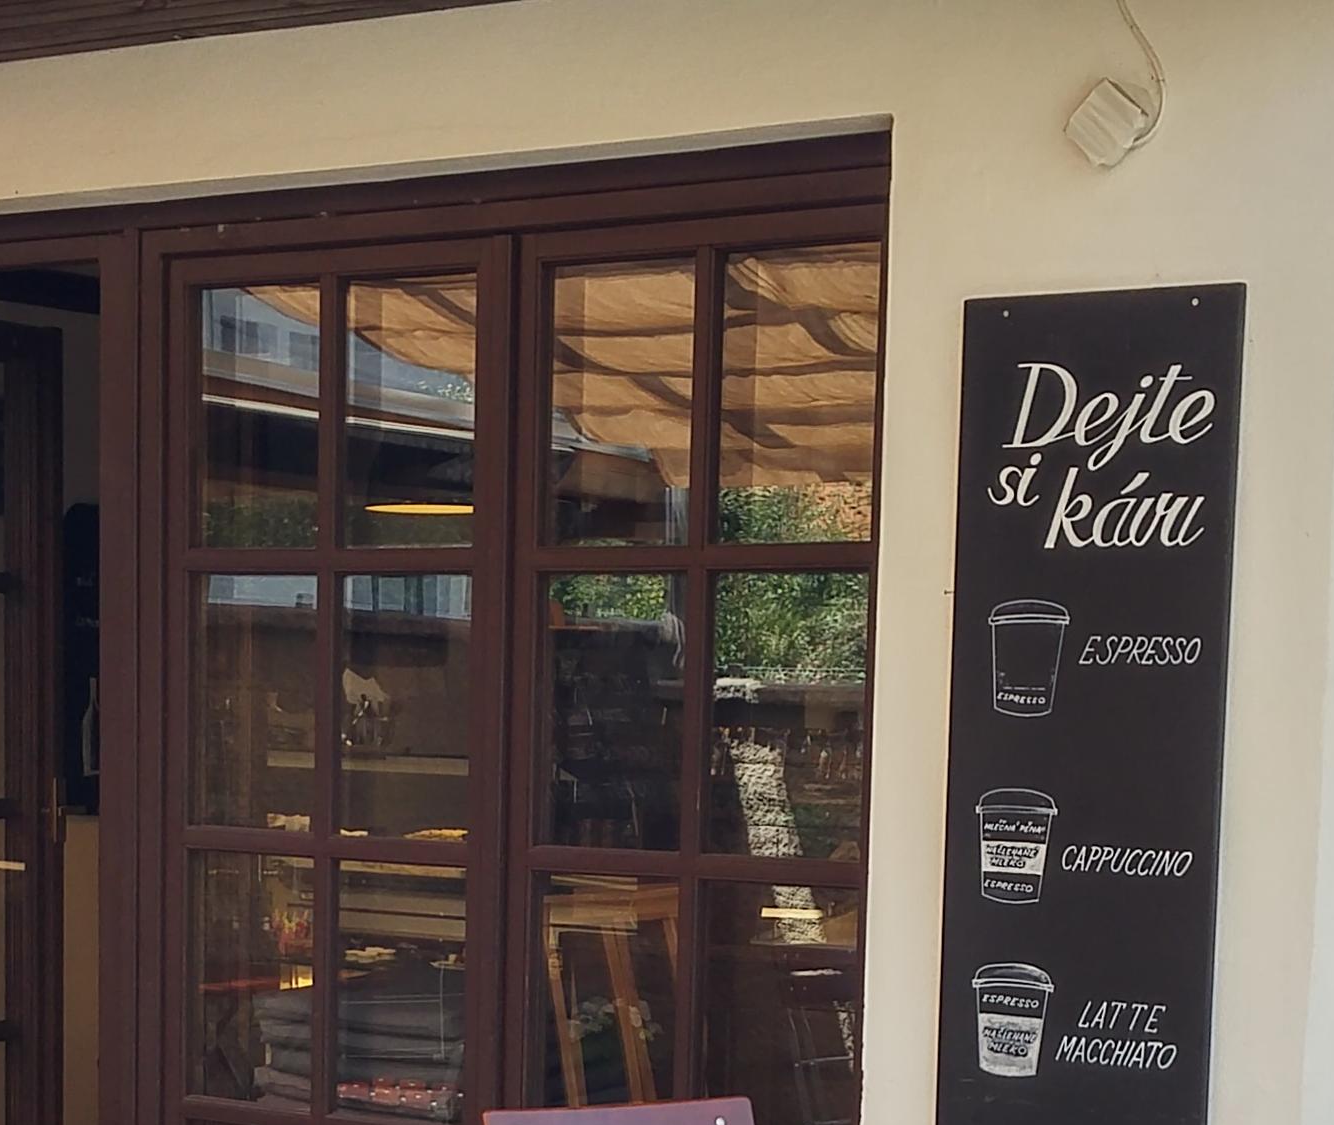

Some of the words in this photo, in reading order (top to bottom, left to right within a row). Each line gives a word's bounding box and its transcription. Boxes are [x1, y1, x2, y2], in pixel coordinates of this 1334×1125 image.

[1001, 362, 1216, 471] Dejte
[987, 452, 1043, 507] si
[1044, 466, 1206, 549] kávu
[1078, 635, 1202, 666] ESPRESSO
[997, 691, 1046, 704] ESPRESSO
[1060, 845, 1193, 878] CAPPUCCINO
[984, 879, 1034, 893] ESPRESSO
[982, 994, 1039, 1008] ESPRESSO
[1077, 1000, 1166, 1034] LATTE
[1054, 1035, 1178, 1070] MACCHIATO
